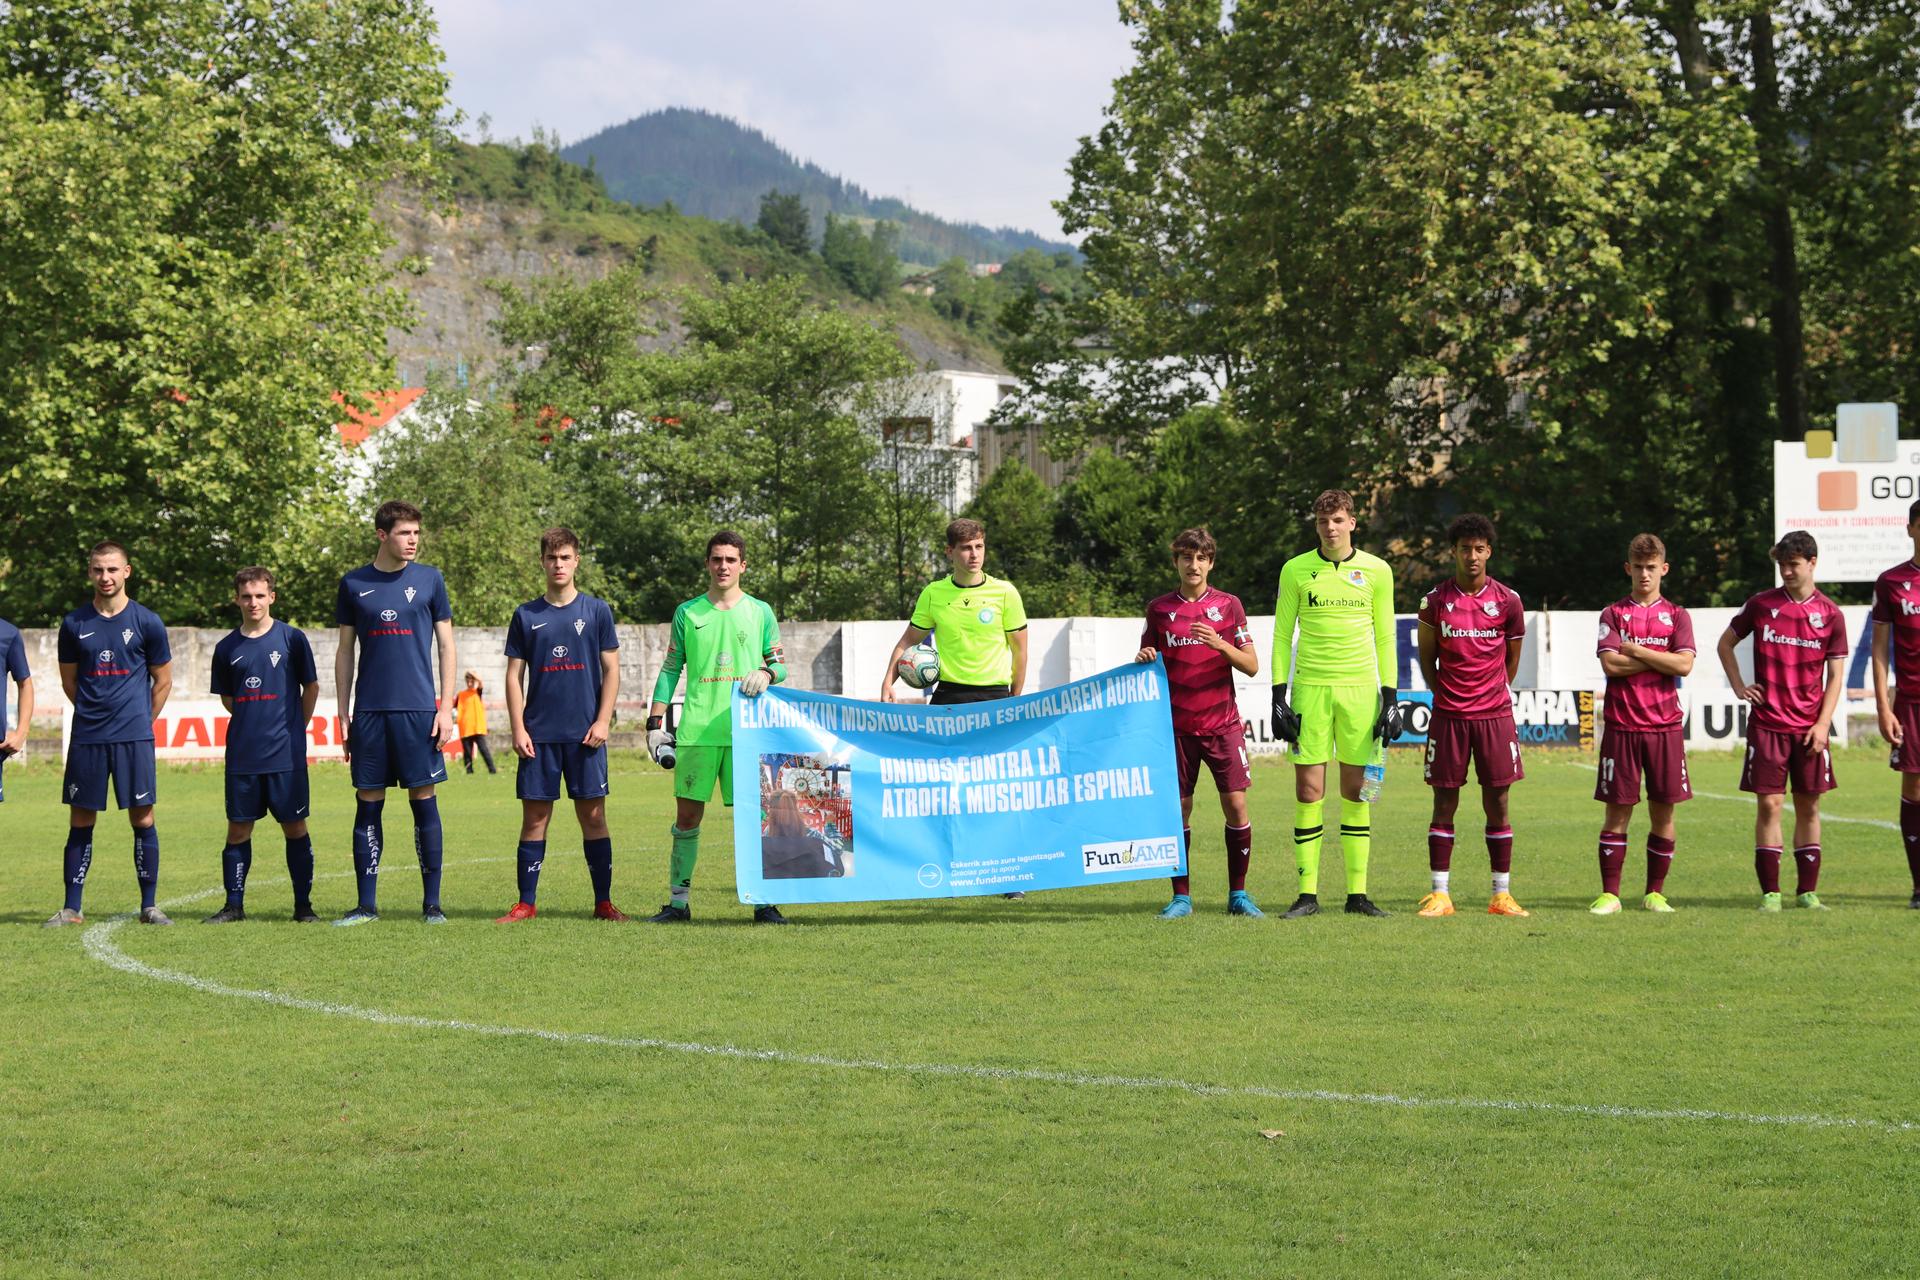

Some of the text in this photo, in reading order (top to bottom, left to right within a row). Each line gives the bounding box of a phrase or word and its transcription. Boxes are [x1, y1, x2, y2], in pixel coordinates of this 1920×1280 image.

[1308, 591, 1366, 607] Kutxabank
[1441, 620, 1498, 638] Kutxabank
[1763, 624, 1822, 650] Kutxabank
[740, 671, 1160, 737] ELKARREKIN MUSKULU-ATROFIA ESPINALAREN AURKA
[1427, 738, 1436, 763] 5
[879, 745, 1061, 784] UNIDOS CONTRA LA
[881, 766, 1154, 818] ATROFIA MUSCULAR ESPINAL
[950, 860, 981, 869] Eskerrik
[982, 858, 1000, 867] asko
[1017, 851, 1066, 863] laguntzagatik
[950, 872, 1034, 886] www.fundame.net
